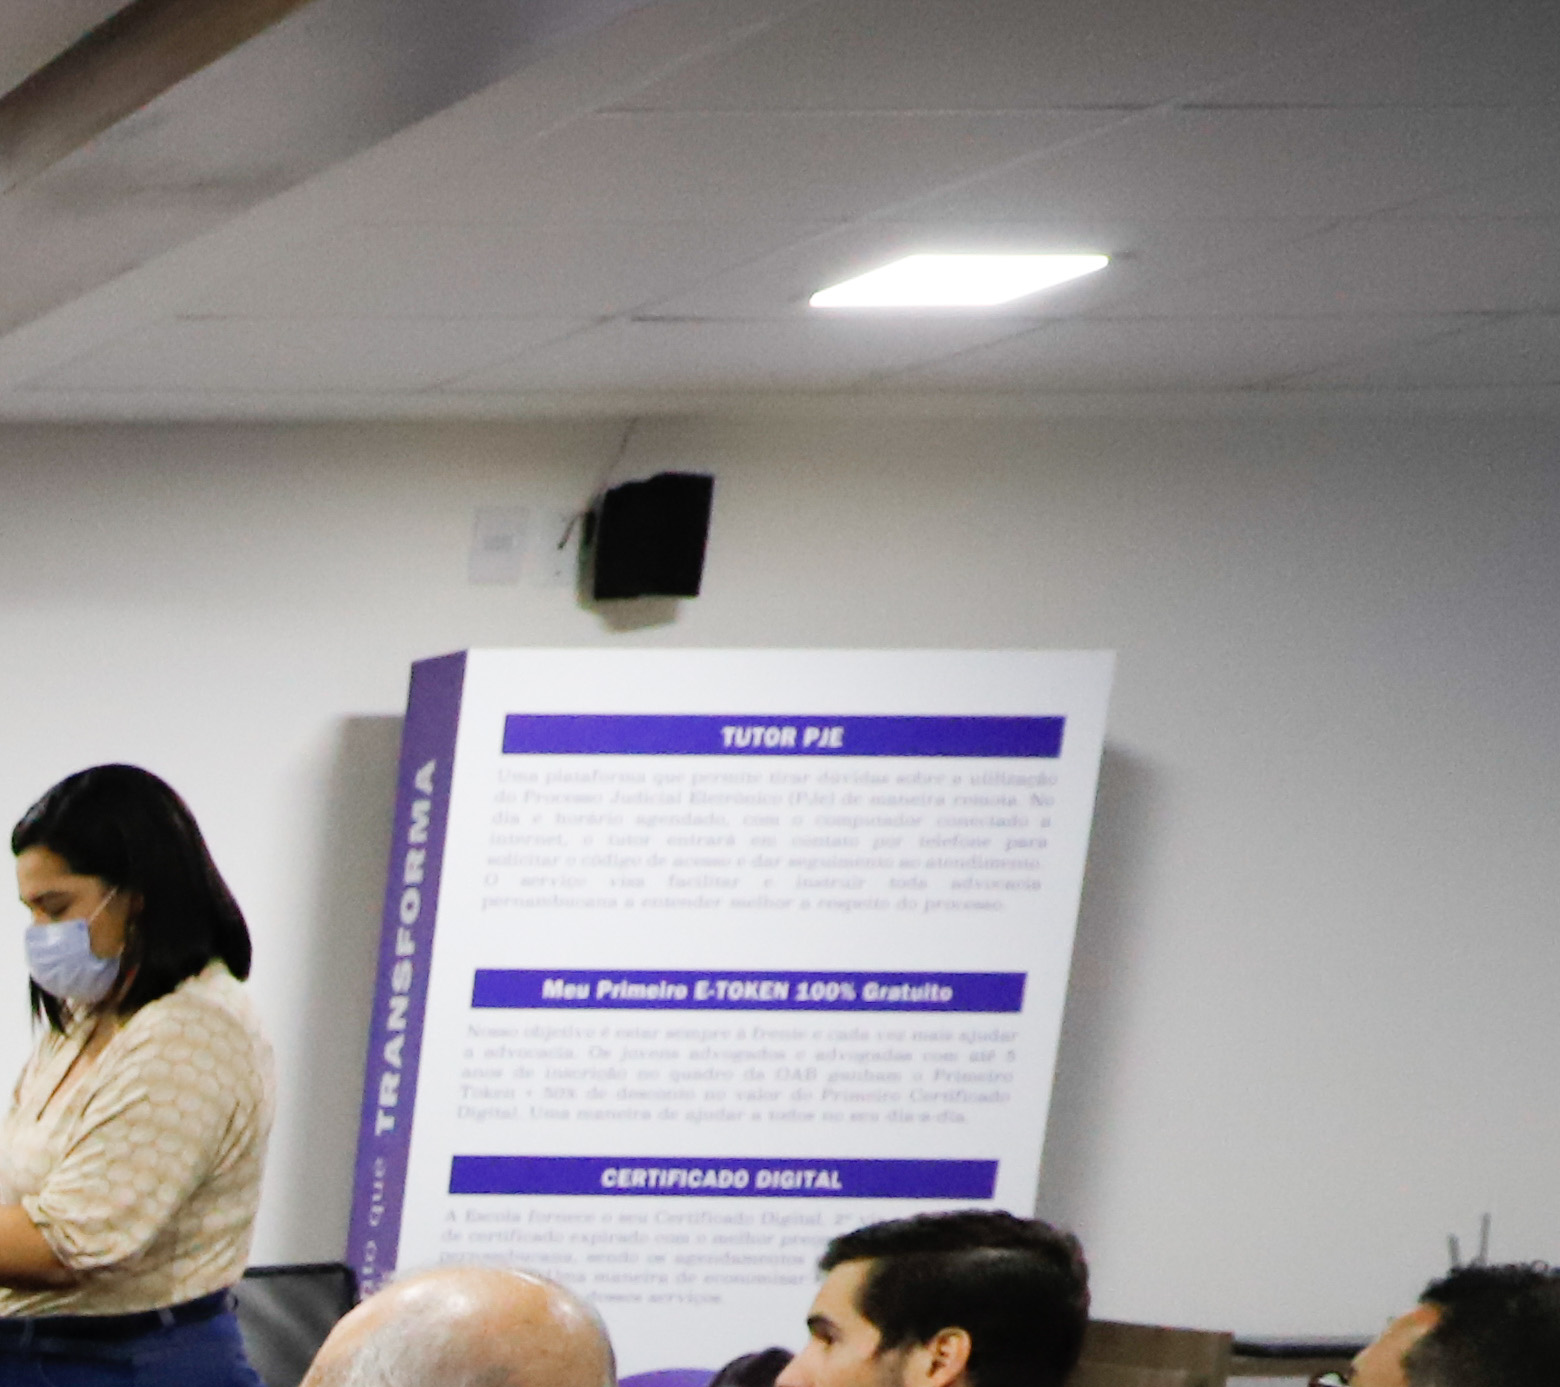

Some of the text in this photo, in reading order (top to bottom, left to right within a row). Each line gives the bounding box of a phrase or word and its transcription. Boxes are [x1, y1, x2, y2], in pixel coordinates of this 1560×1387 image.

[722, 725, 845, 748] TUTOR PJE
[374, 759, 437, 1136] TRANSFORMA
[542, 978, 953, 1002] Meu Primeiro E-TOKEN 100% Gratuito
[601, 1167, 843, 1190] CERTIFICADO DIGITAL
